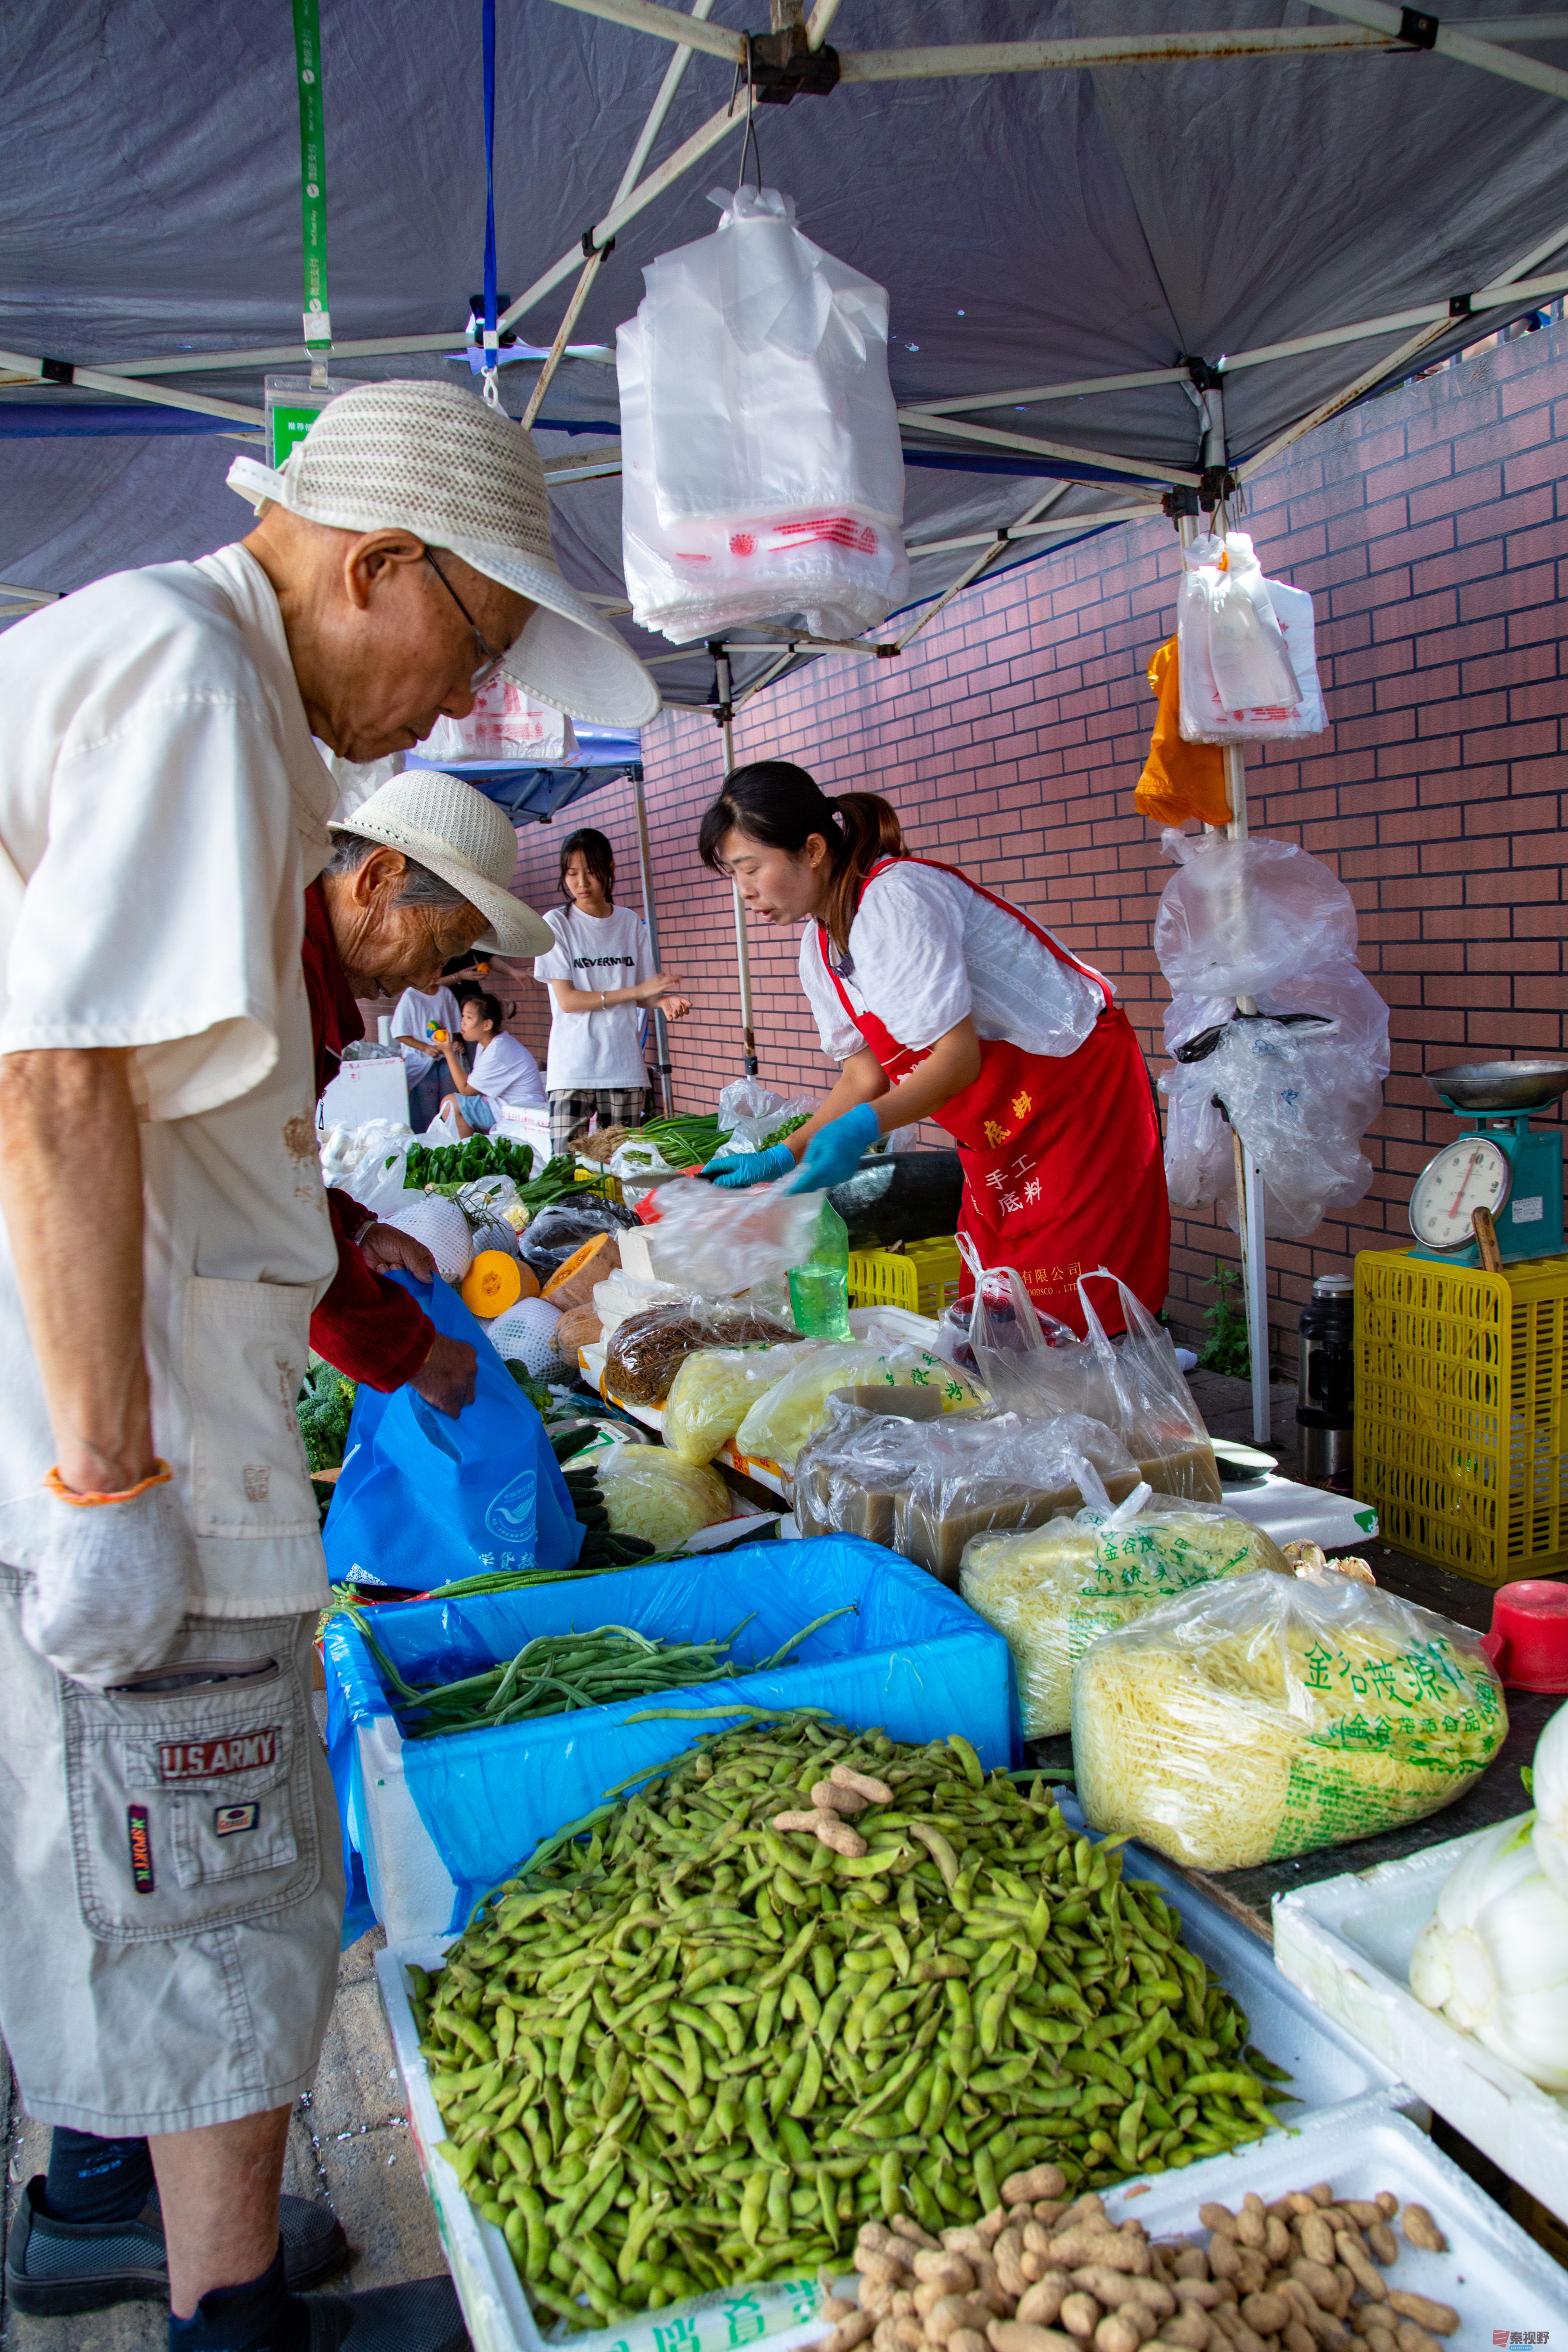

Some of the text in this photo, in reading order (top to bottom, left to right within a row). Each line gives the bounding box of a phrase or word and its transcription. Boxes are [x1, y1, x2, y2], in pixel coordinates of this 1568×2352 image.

[985, 1154, 1037, 1190] 手工
[998, 1177, 1043, 1216] 底料
[1304, 1640, 1449, 1708] 金谷茂源
